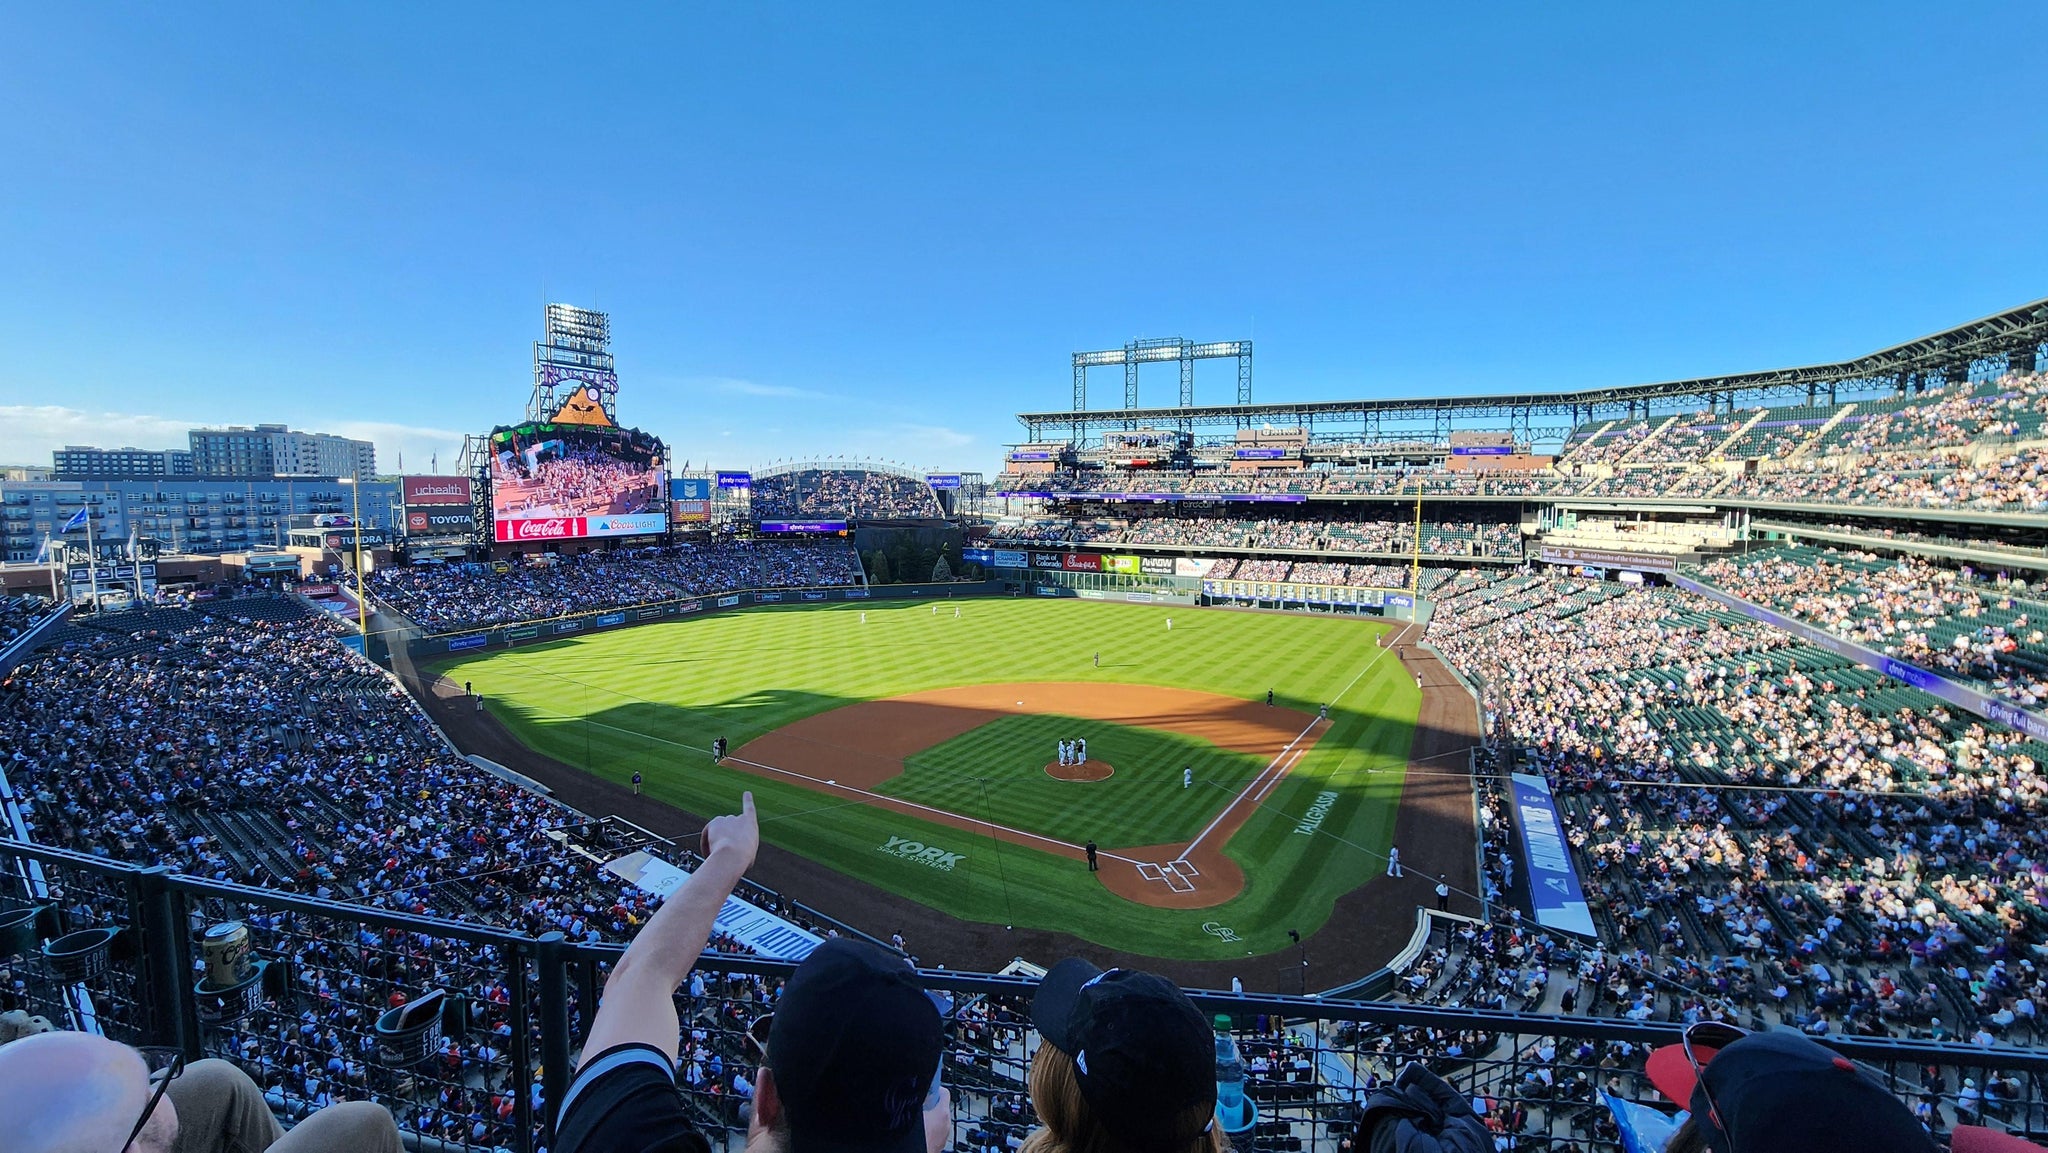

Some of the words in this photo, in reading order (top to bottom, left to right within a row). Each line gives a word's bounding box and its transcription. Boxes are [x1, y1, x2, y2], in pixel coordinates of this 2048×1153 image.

[929, 477, 943, 485] xfinity
[415, 484, 462, 496] uchealth
[430, 515, 471, 524] TOYOTA
[610, 519, 635, 530] Coors
[635, 520, 657, 529] LIGHT
[341, 535, 383, 545] TUNDRA
[963, 553, 990, 561] Southwt
[1036, 560, 1062, 569] Colorado
[1390, 597, 1410, 607] xfinity
[1888, 662, 1906, 679] xfinity
[1980, 700, 1991, 713] It's
[1990, 704, 2014, 725] giving
[2013, 711, 2026, 729] full
[2027, 717, 2046, 737] bars
[877, 845, 906, 858] SPACE
[883, 835, 967, 868] YORK
[907, 855, 954, 872] SYSTEMS
